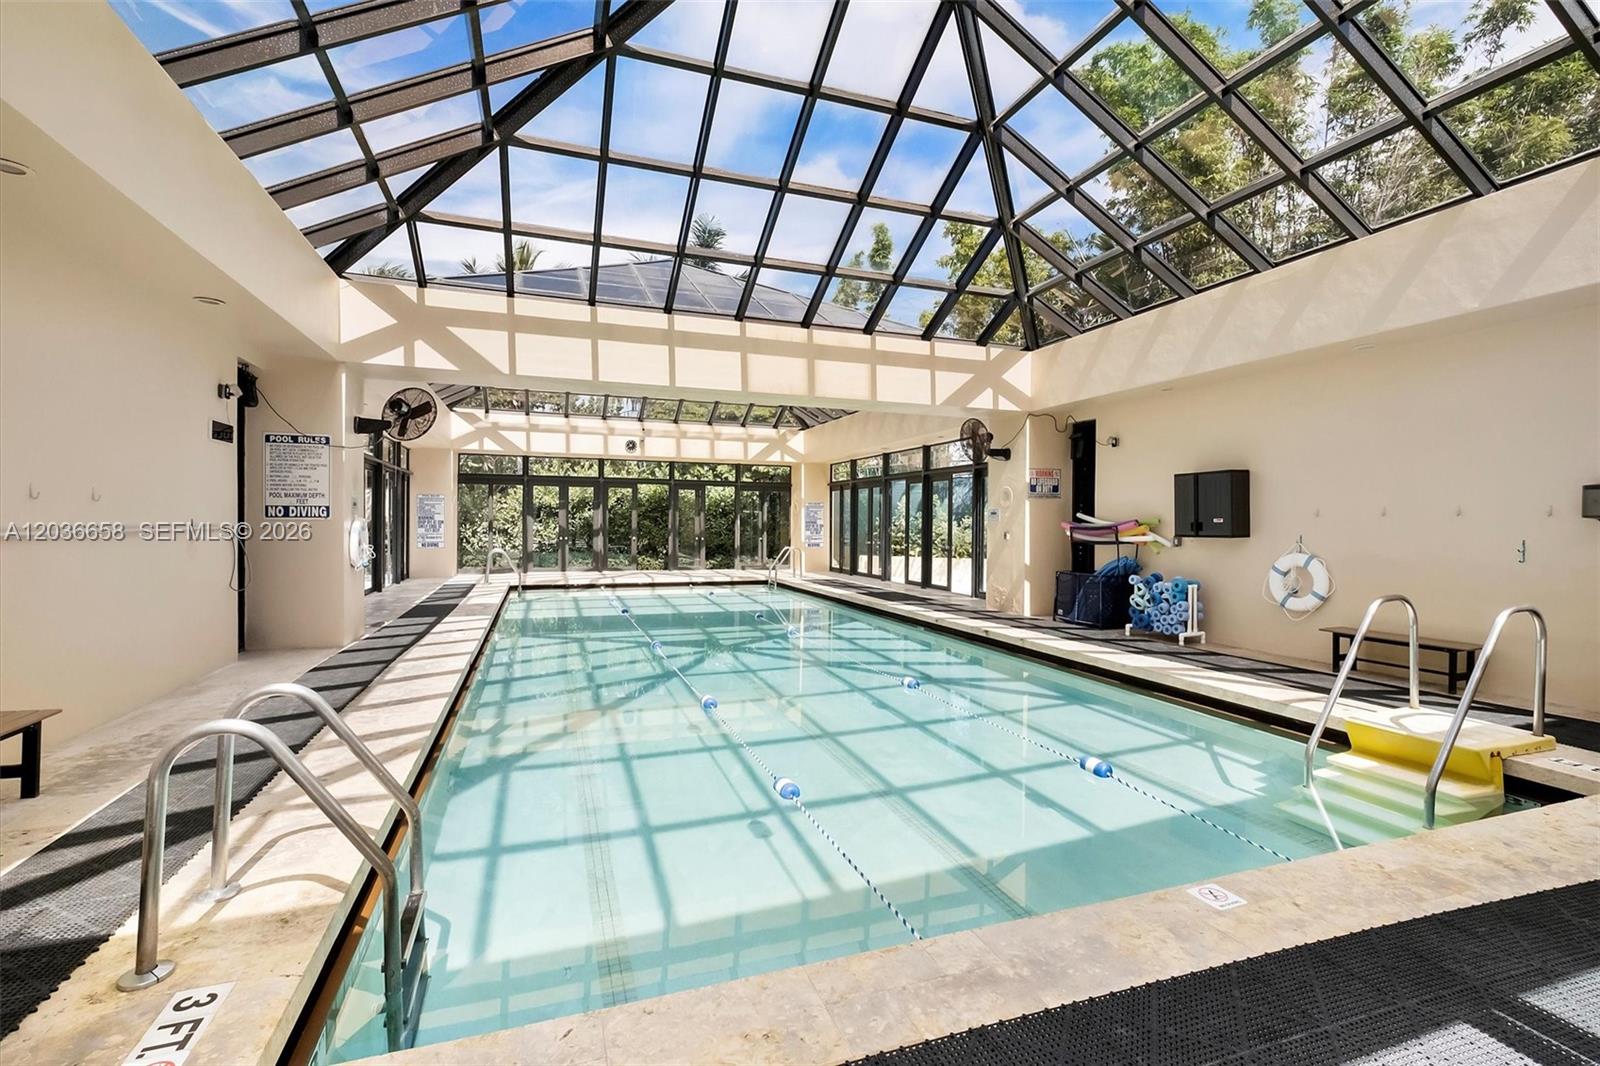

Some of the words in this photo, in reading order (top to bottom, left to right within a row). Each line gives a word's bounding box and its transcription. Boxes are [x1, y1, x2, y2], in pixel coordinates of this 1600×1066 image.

[270, 435, 294, 443] POOL
[298, 436, 326, 444] RULES
[268, 506, 284, 517] NO
[289, 506, 327, 517] DIVING
[172, 992, 219, 1012] 3
